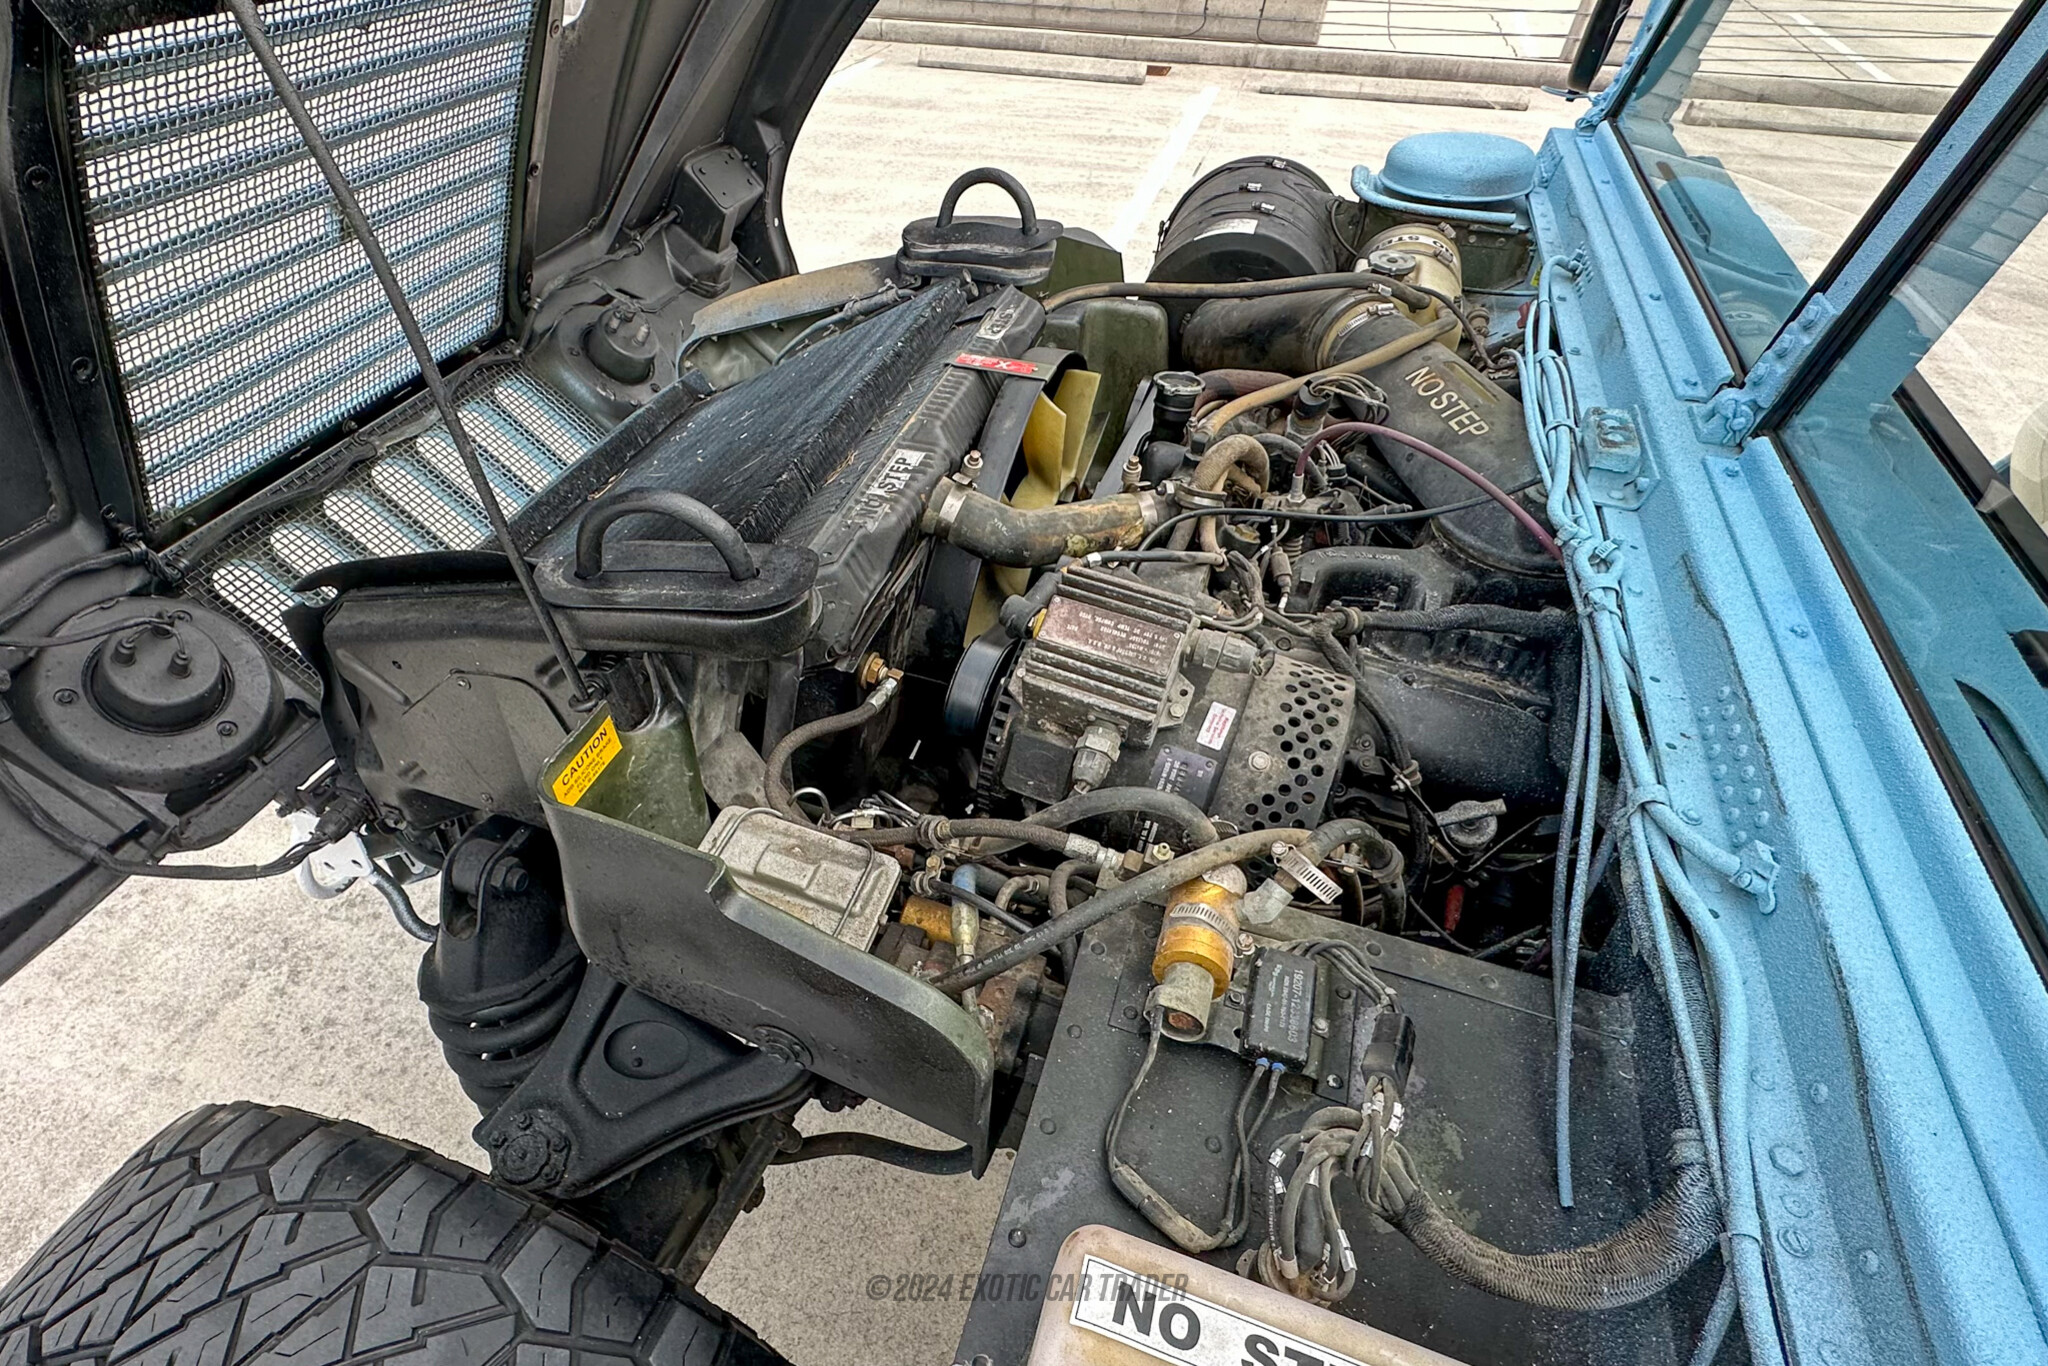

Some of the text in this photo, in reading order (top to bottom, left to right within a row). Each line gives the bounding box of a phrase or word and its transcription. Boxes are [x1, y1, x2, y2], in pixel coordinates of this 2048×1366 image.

[1405, 366, 1490, 436] NO STEP
[877, 456, 914, 494] STEP
[562, 727, 607, 786] CAUTION
[1112, 1281, 1201, 1351] NO
